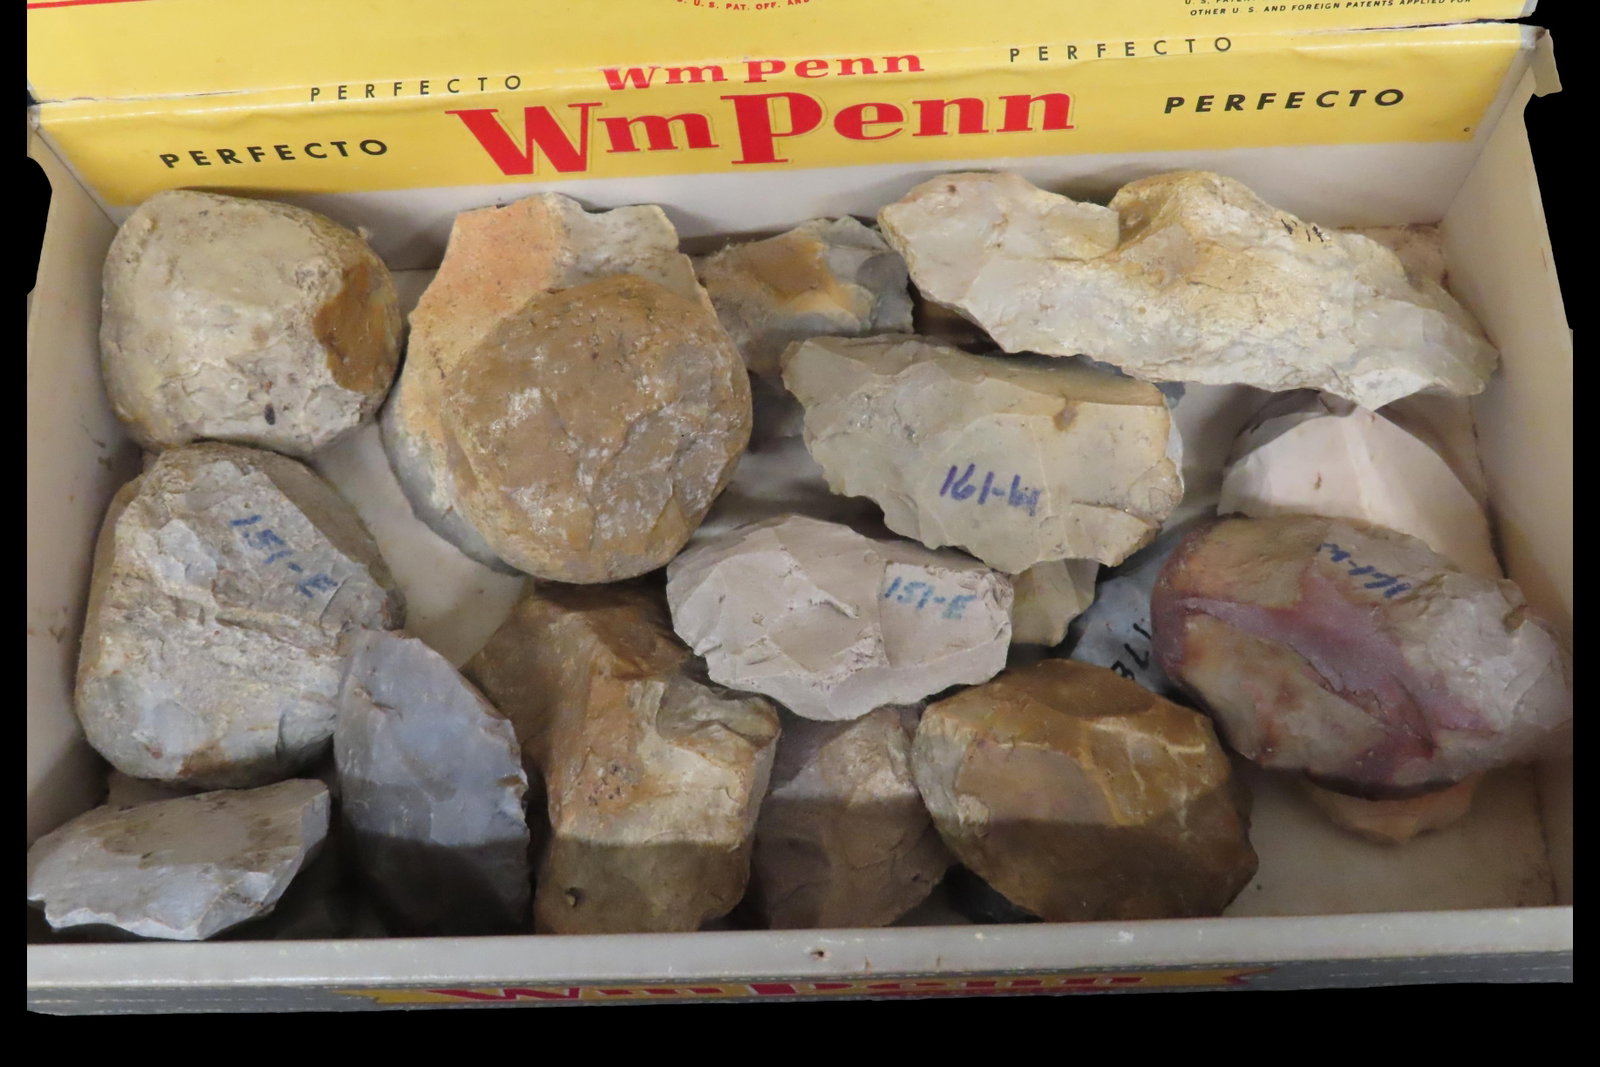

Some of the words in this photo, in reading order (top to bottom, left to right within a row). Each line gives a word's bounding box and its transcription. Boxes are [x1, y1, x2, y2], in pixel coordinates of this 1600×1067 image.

[1190, 8, 1226, 16] OTHER
[1291, 2, 1340, 11] FOREIGN
[1345, 0, 1393, 8] PATENTS
[1010, 37, 1232, 63] PERFECTO
[603, 64, 728, 91] Wm
[742, 54, 925, 83] Penn
[310, 75, 521, 101] PERFECTO
[1164, 88, 1405, 115] PERFECTO
[159, 139, 387, 168] PERFECTO
